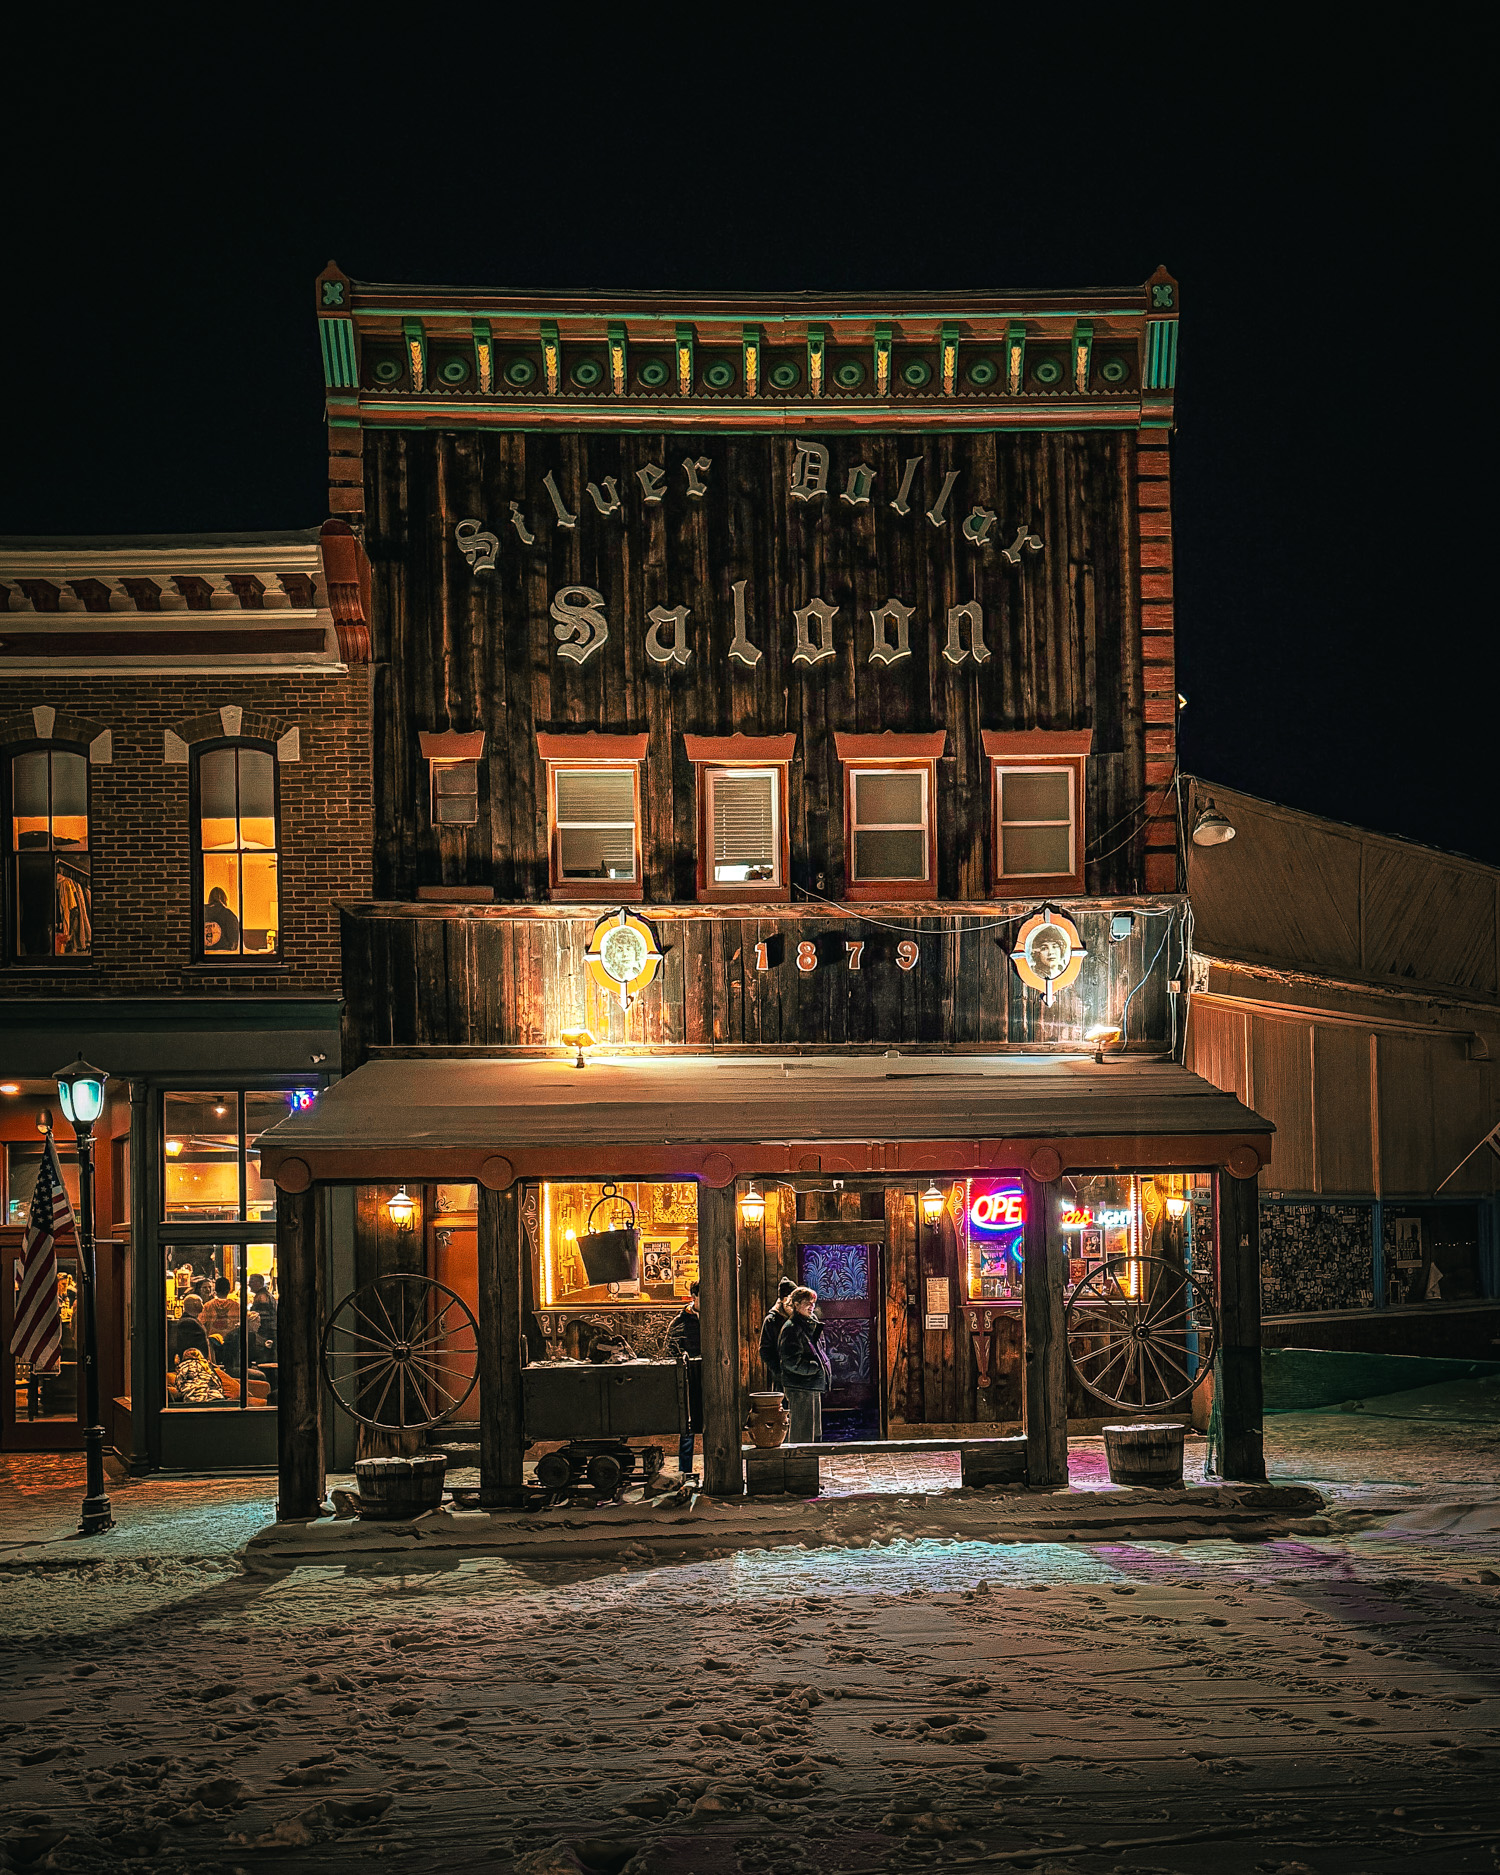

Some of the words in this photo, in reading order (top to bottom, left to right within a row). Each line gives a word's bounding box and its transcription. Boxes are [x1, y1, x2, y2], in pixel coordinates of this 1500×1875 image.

[454, 456, 712, 575] Silver
[790, 439, 1044, 563] Dollar
[549, 580, 991, 665] Saloon
[754, 941, 919, 972] 1879
[971, 1195, 1023, 1223] OPE
